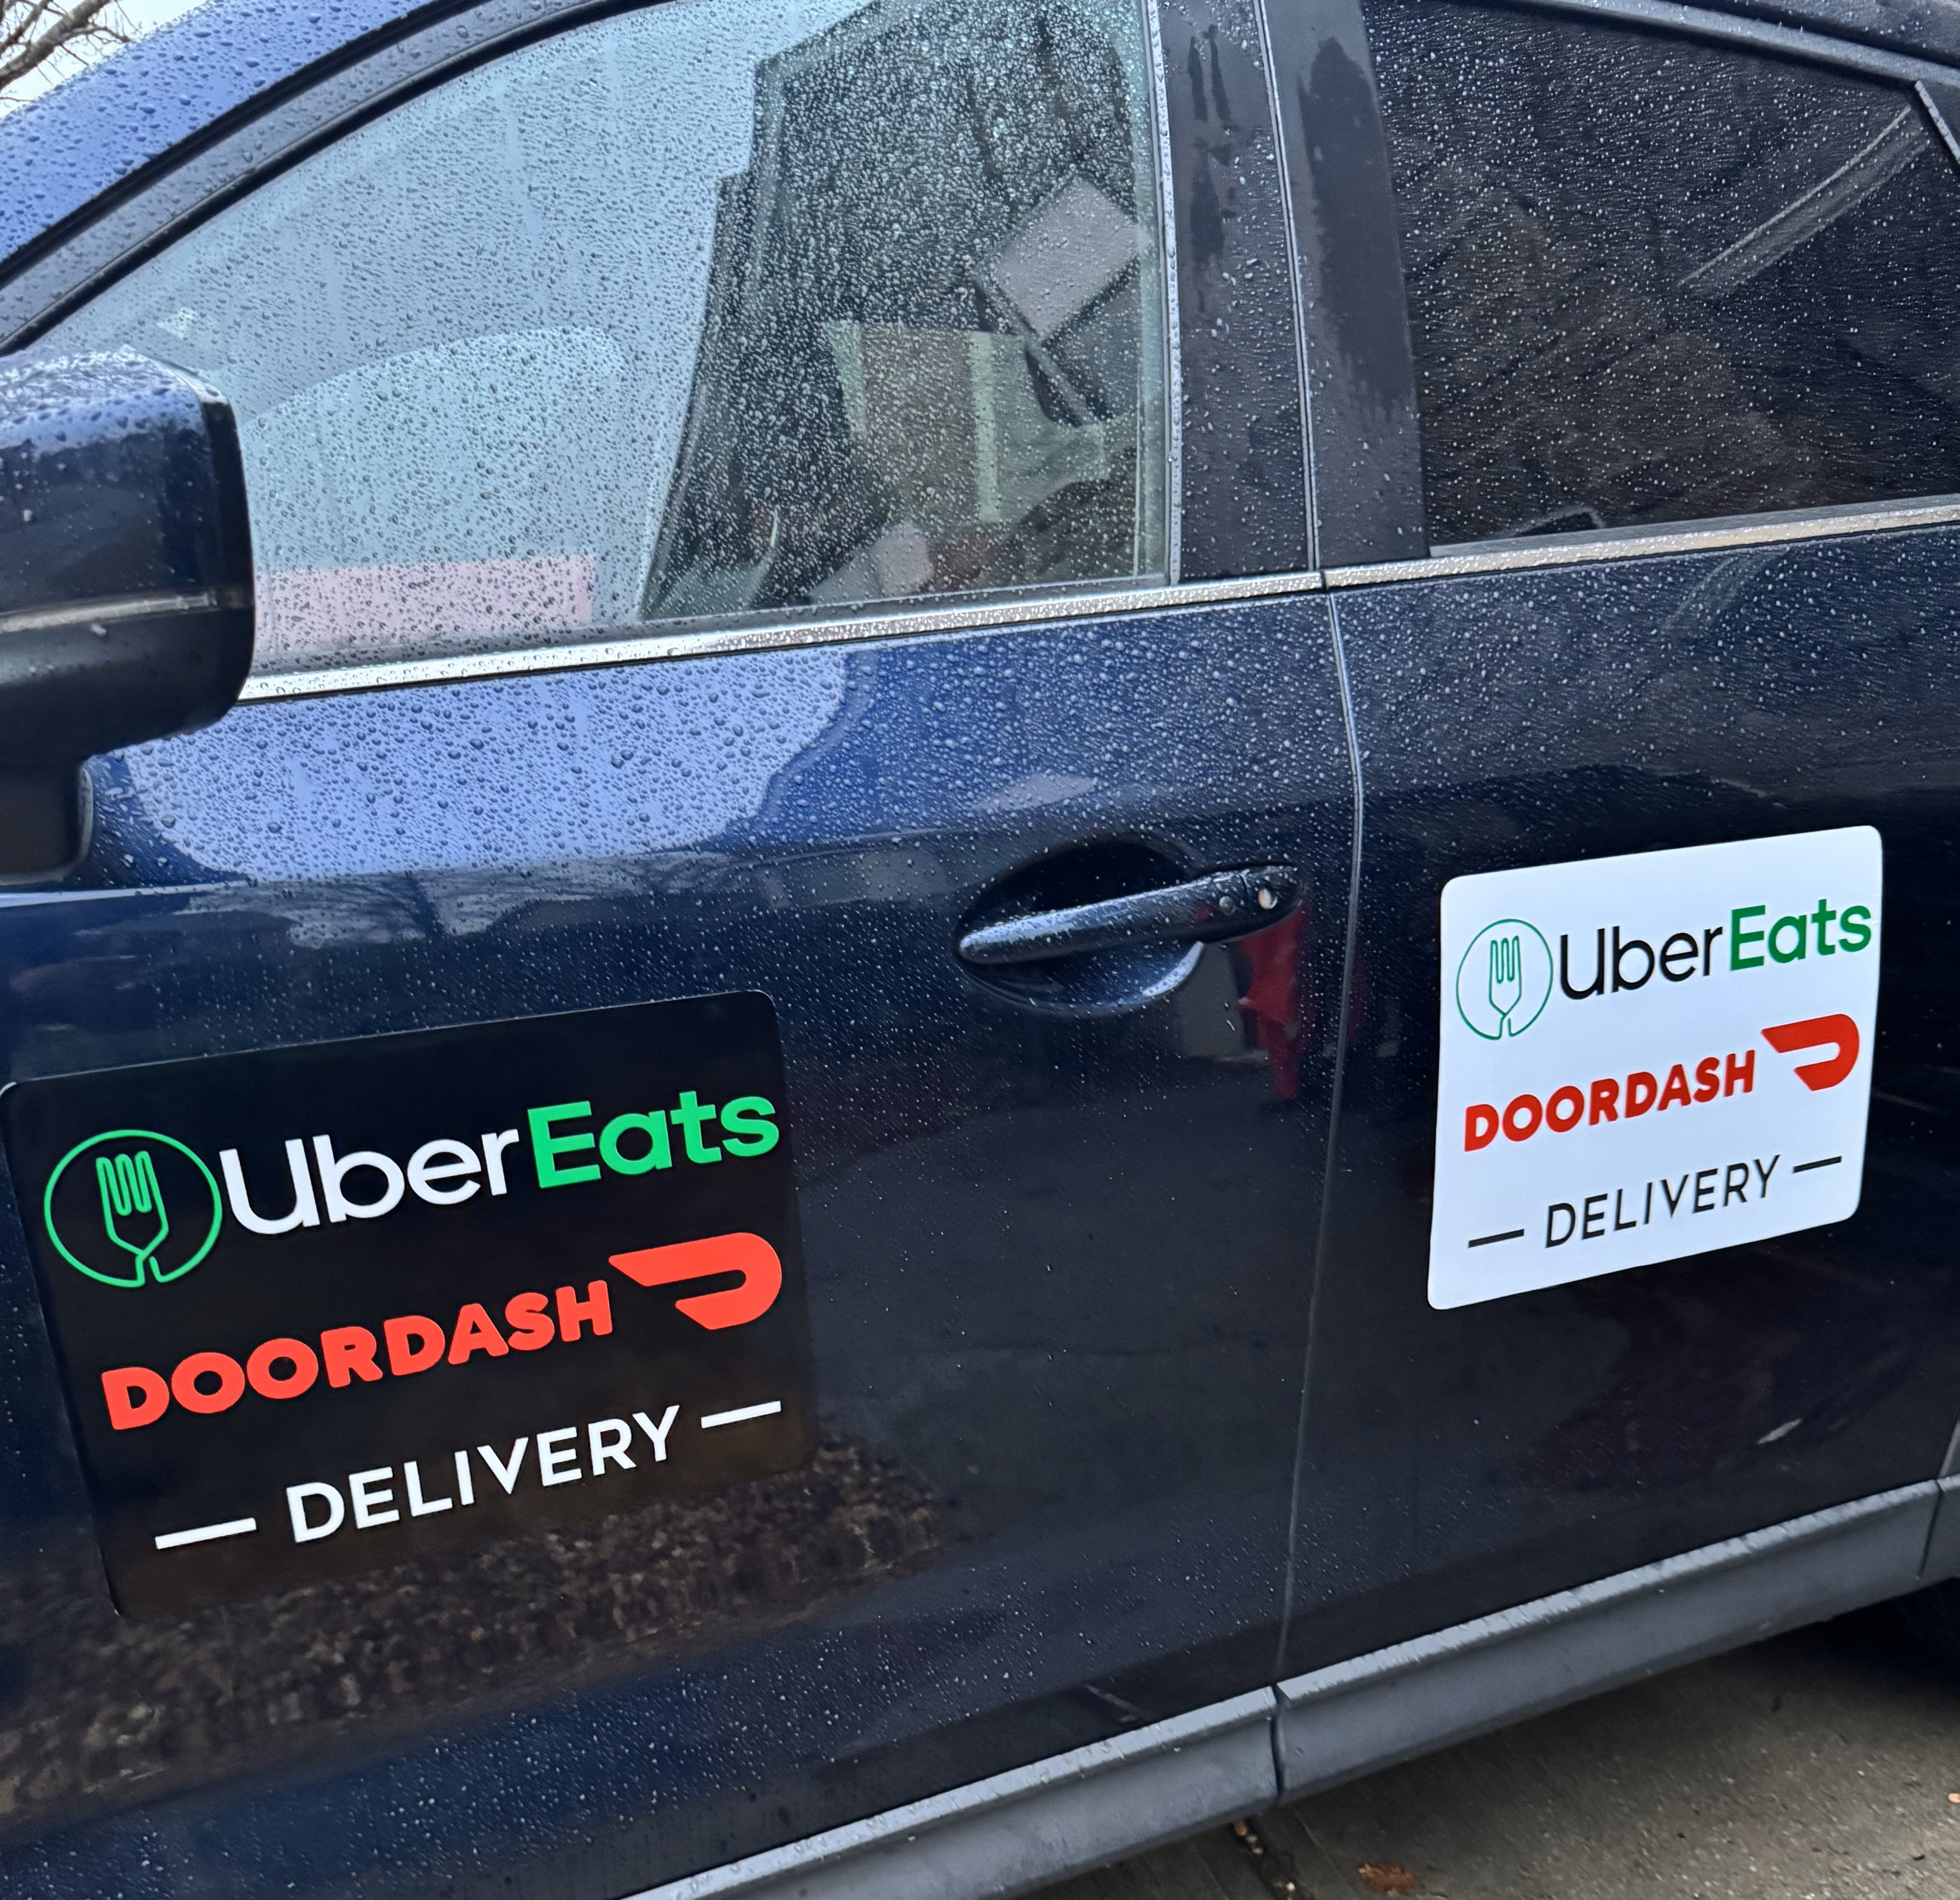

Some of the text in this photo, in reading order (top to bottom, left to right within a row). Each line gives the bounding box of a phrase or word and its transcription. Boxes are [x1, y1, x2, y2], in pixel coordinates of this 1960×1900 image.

[1464, 1050, 1755, 1152] DOORDASH
[1545, 1154, 1781, 1249] DELIVERY
[101, 1280, 613, 1430] DOORDASH
[286, 1405, 680, 1543] DELIVERY
